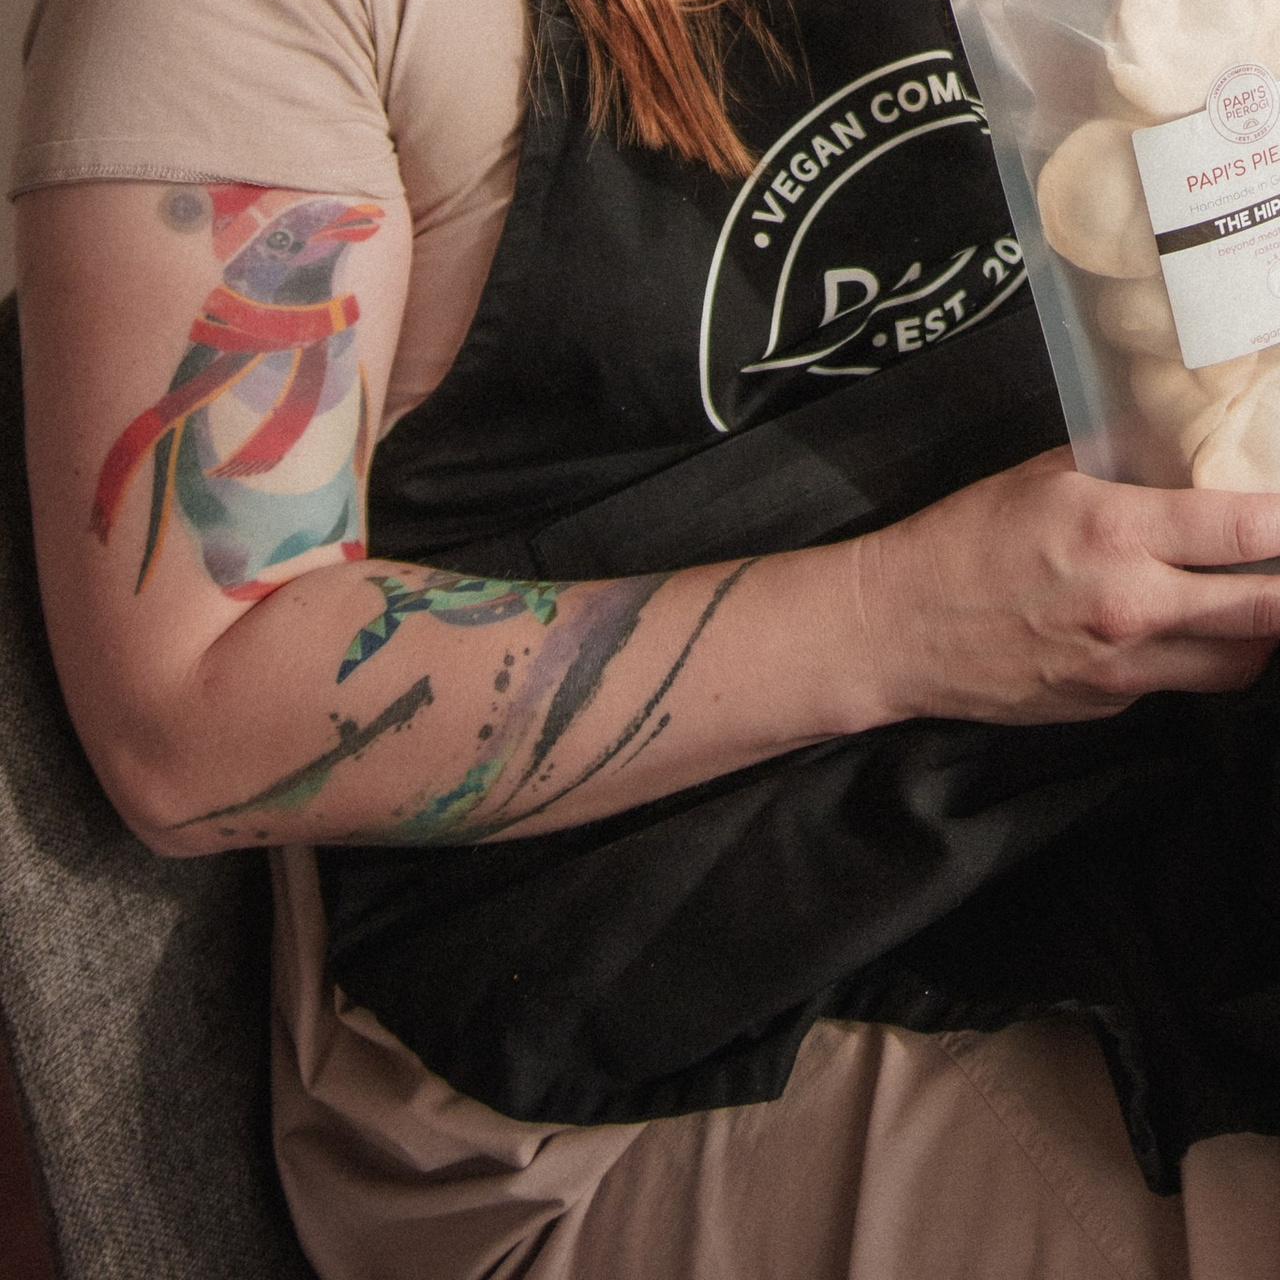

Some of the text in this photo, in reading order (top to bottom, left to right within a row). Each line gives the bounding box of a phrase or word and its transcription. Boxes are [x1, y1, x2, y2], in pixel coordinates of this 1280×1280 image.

[1223, 85, 1267, 111] PAPI'S
[1225, 97, 1269, 122] PIEROGI
[751, 70, 964, 224] VEGAN COM
[1186, 159, 1247, 193] PAPI'S
[1189, 183, 1255, 215] Handmade
[1257, 179, 1268, 193] in
[1214, 209, 1252, 236] THE
[982, 237, 1023, 287] 20
[1217, 238, 1256, 258] beyond
